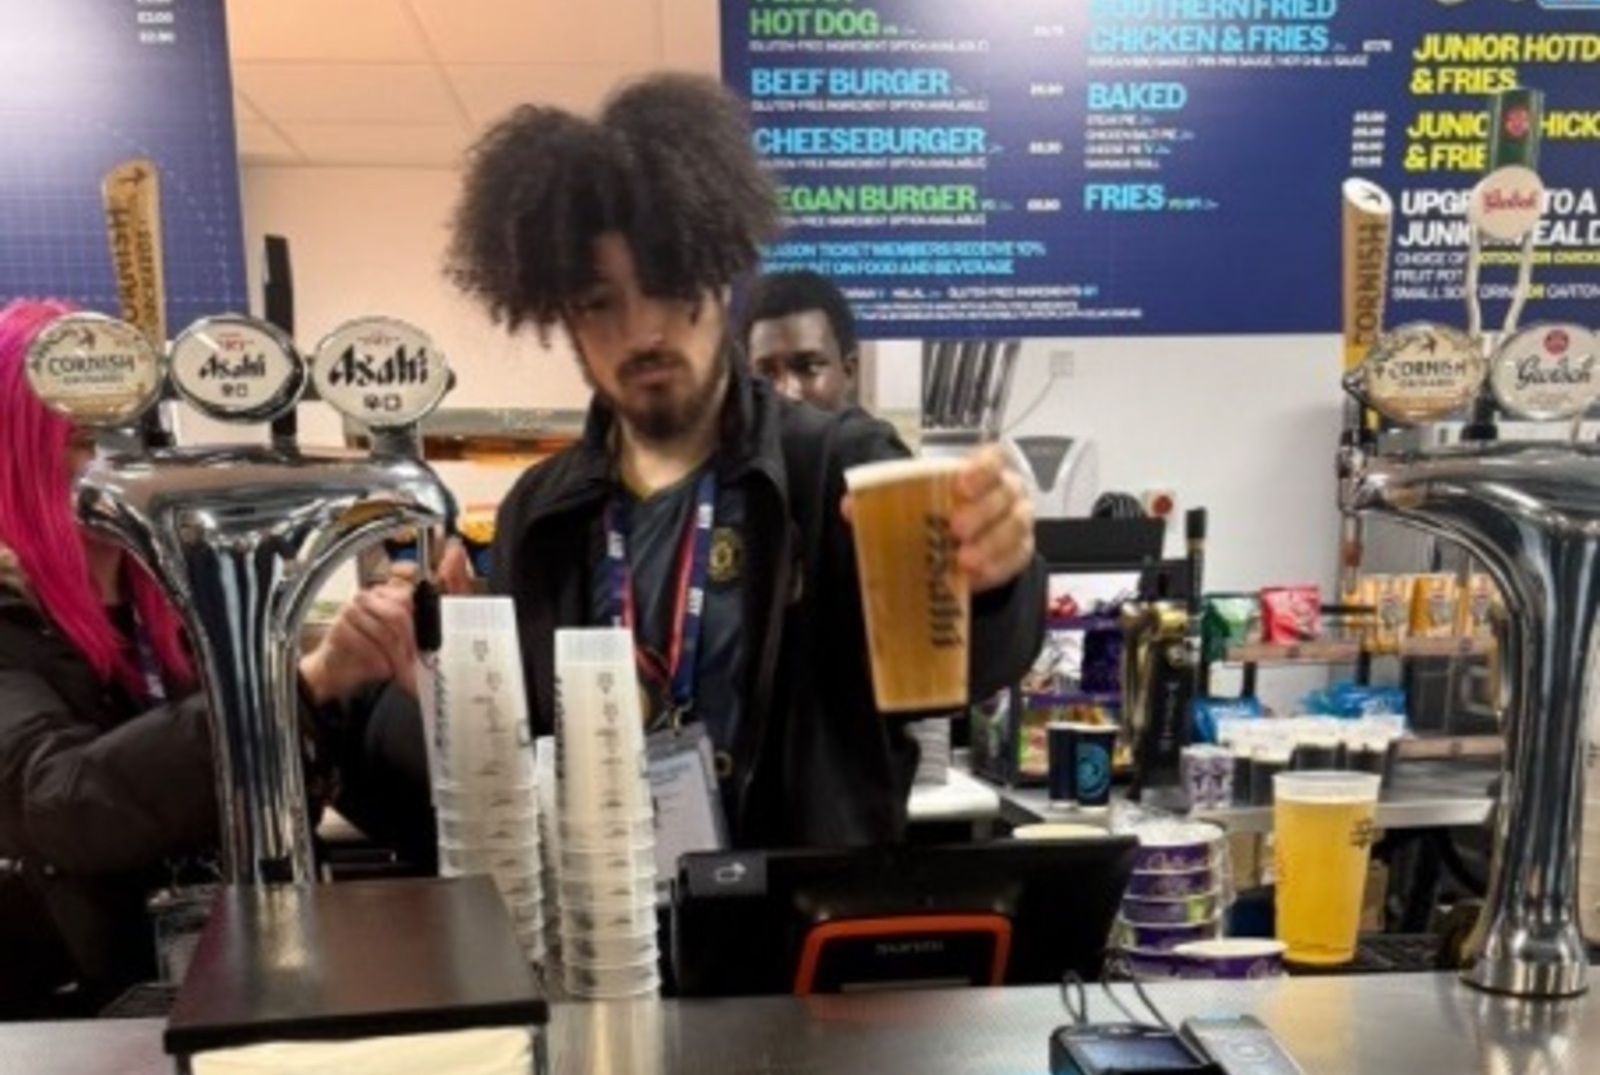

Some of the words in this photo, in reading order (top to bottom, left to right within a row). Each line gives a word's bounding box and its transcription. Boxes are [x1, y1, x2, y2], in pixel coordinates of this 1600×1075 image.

[750, 9, 811, 35] HOT
[815, 9, 879, 36] DOG
[1089, 25, 1214, 52] CHICKEN
[1221, 25, 1244, 52] &
[1249, 24, 1329, 51] FRIES
[1412, 34, 1519, 61] JUNIOR
[752, 68, 825, 95] BEEF
[829, 68, 950, 95] BURGER
[1410, 67, 1434, 94] &
[1437, 67, 1516, 93] FRIES
[1087, 82, 1187, 109] BAKED
[1406, 112, 1489, 138] JUNIO
[754, 128, 986, 154] CHEESEBURGER
[1404, 144, 1427, 169] &
[1430, 144, 1487, 169] FRIE
[777, 184, 856, 211] EGAN
[861, 184, 978, 211] BURGER
[1084, 184, 1165, 210] FRIES
[1575, 189, 1597, 215] A
[819, 241, 869, 257] TICKET
[873, 241, 950, 257] MEMBERS
[953, 241, 1016, 257] RECEIVE
[1018, 241, 1046, 257] 10%
[858, 260, 896, 275] FOOD
[900, 260, 930, 274] AND
[934, 260, 1014, 274] BEVERAGE
[1393, 269, 1434, 282] FRUIT
[1437, 269, 1464, 282] POT
[48, 353, 135, 377] CORNISH
[199, 353, 266, 380] Asahi
[328, 344, 429, 387] Asahi
[1388, 359, 1467, 380] CORNISH
